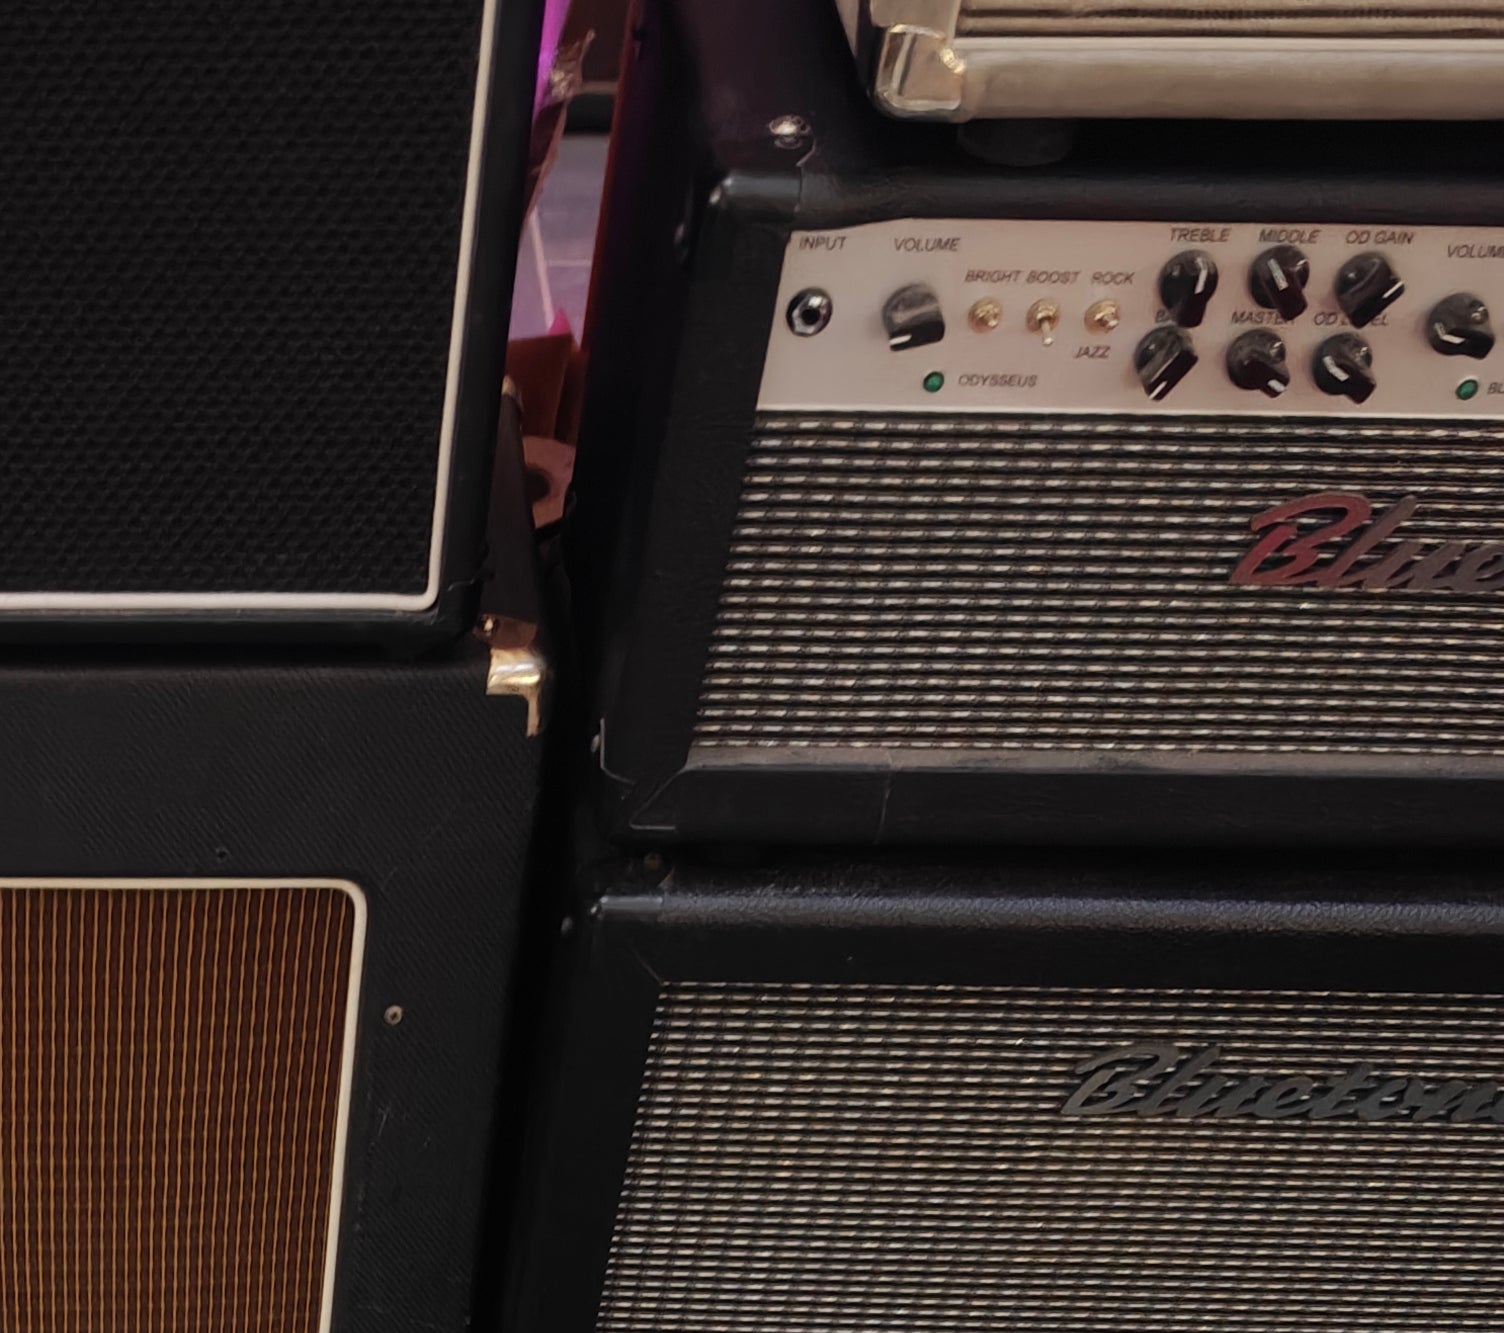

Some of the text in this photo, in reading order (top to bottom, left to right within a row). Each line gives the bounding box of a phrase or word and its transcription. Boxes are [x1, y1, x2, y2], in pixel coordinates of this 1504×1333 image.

[1170, 227, 1232, 243] TREBLE
[1259, 229, 1322, 244] MIDDLE
[1346, 230, 1414, 245] OD GAIN
[799, 236, 847, 250] INPUT
[894, 237, 961, 252] VOLUME
[964, 270, 1025, 284] BRIGHT
[1025, 270, 1081, 284] BOOST
[1091, 271, 1136, 285] ROCK
[1073, 346, 1111, 359] JAZZ
[958, 374, 1038, 388] ODYSSEUS
[1060, 1043, 1504, 1122] Blueton
